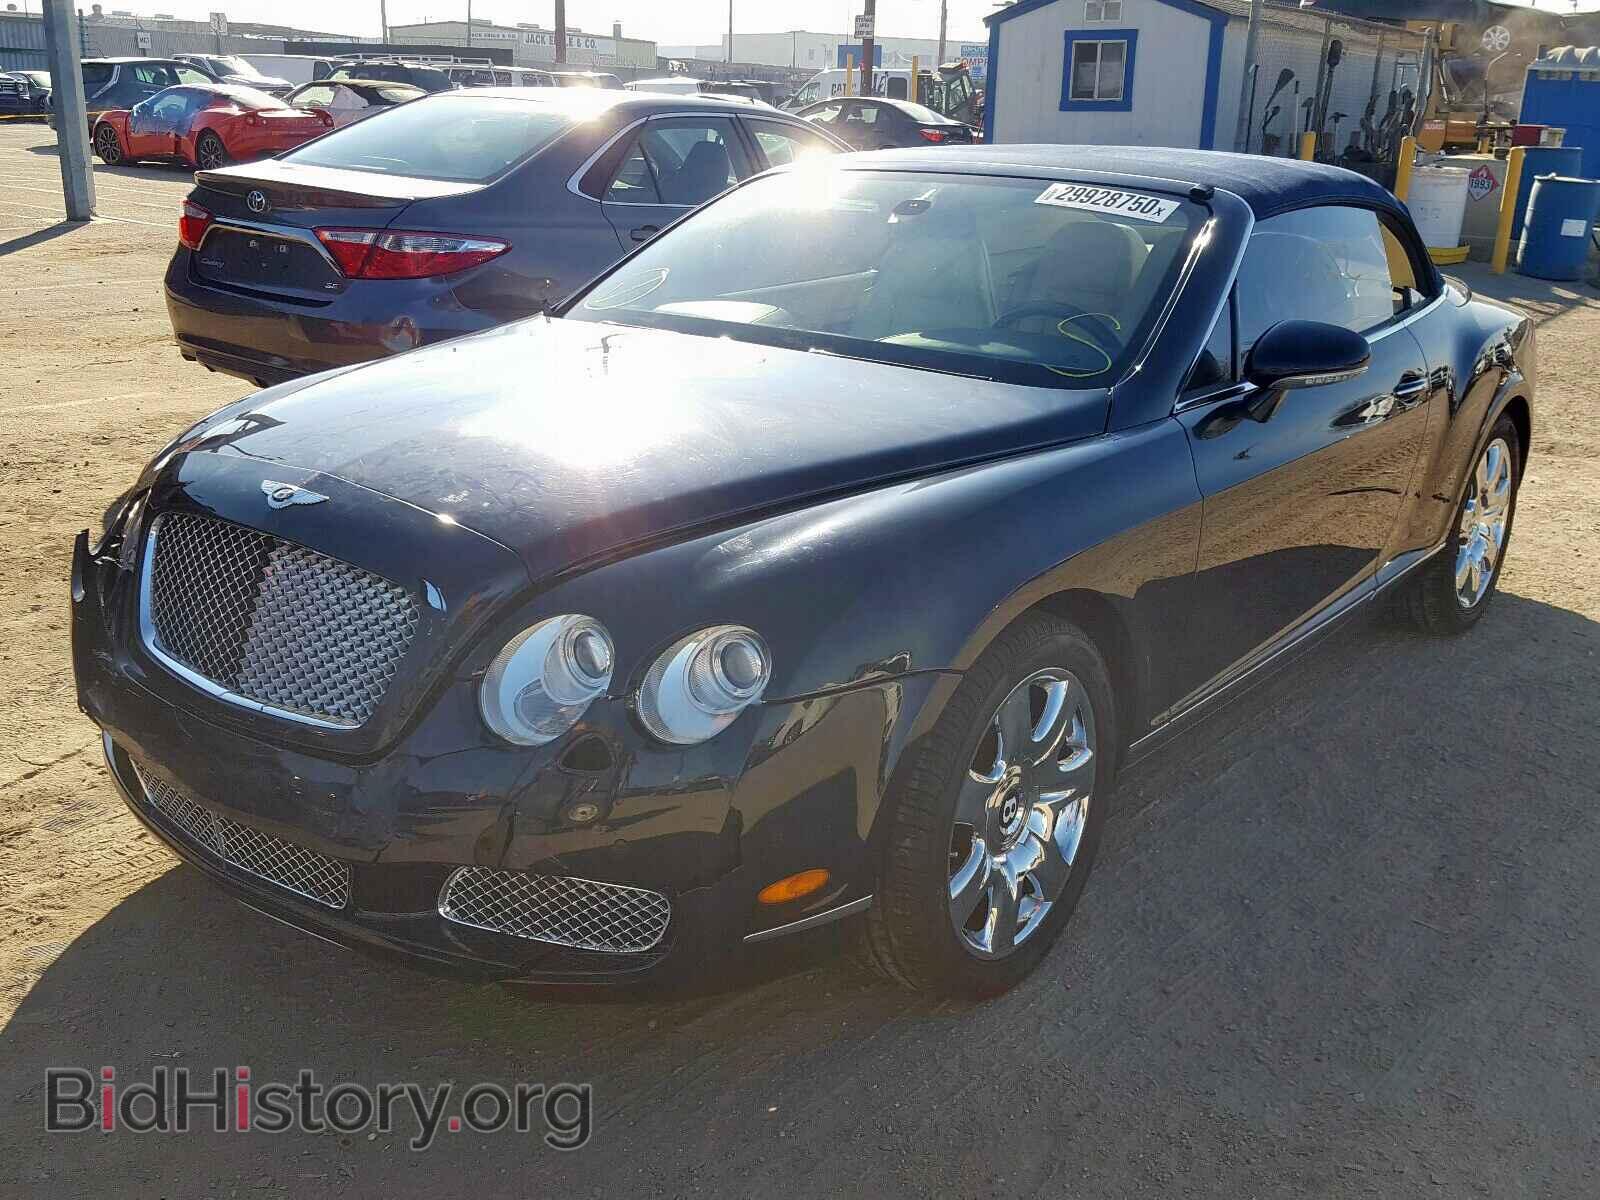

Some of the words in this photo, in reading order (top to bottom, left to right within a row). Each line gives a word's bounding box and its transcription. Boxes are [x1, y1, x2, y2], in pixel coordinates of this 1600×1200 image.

[525, 33, 546, 45] JACK
[576, 38, 582, 47] &
[585, 39, 597, 48] CO.
[1470, 178, 1491, 190] 1993
